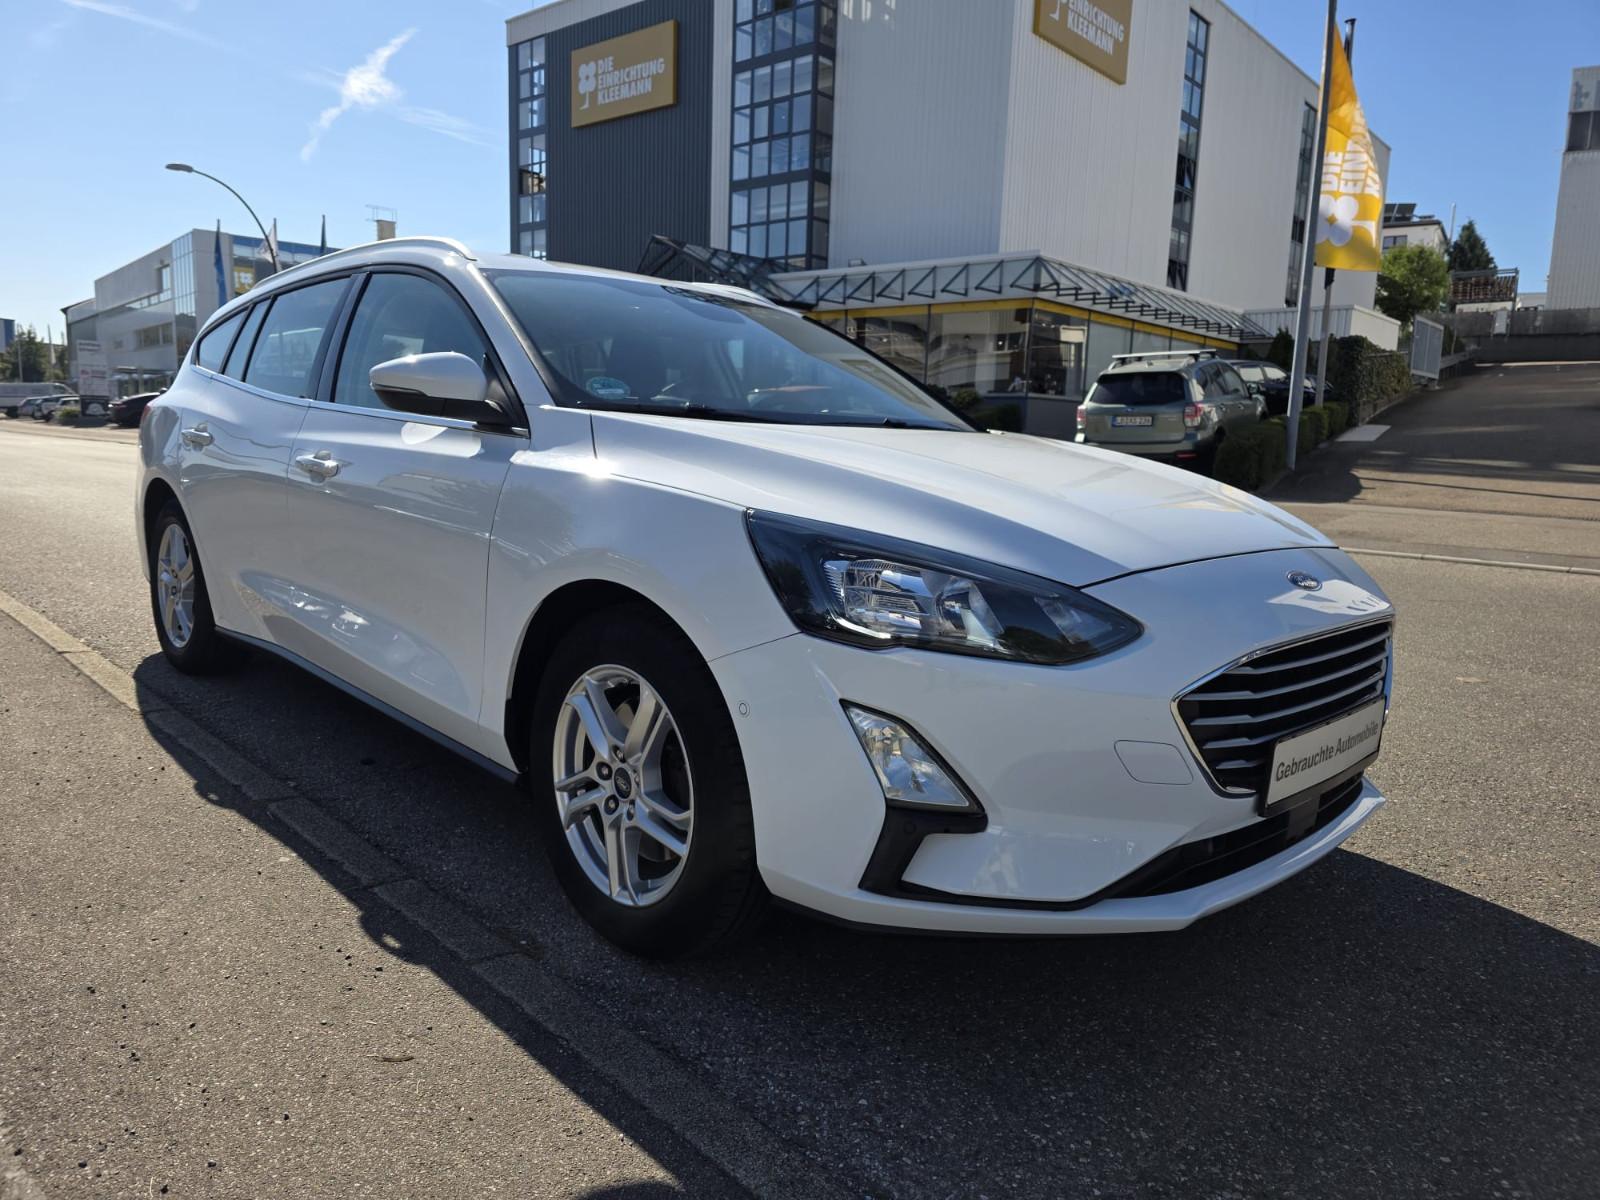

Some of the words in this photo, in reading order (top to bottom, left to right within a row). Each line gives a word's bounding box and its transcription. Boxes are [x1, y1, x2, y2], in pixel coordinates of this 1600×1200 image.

[1067, 9, 1114, 56] KLEEMANN
[597, 56, 615, 74] DIE
[598, 57, 665, 89] EINRICHTUNG
[597, 77, 652, 105] KLEEMANN
[1275, 745, 1334, 782] Gebrauchte
[1335, 721, 1379, 757] Automobile
